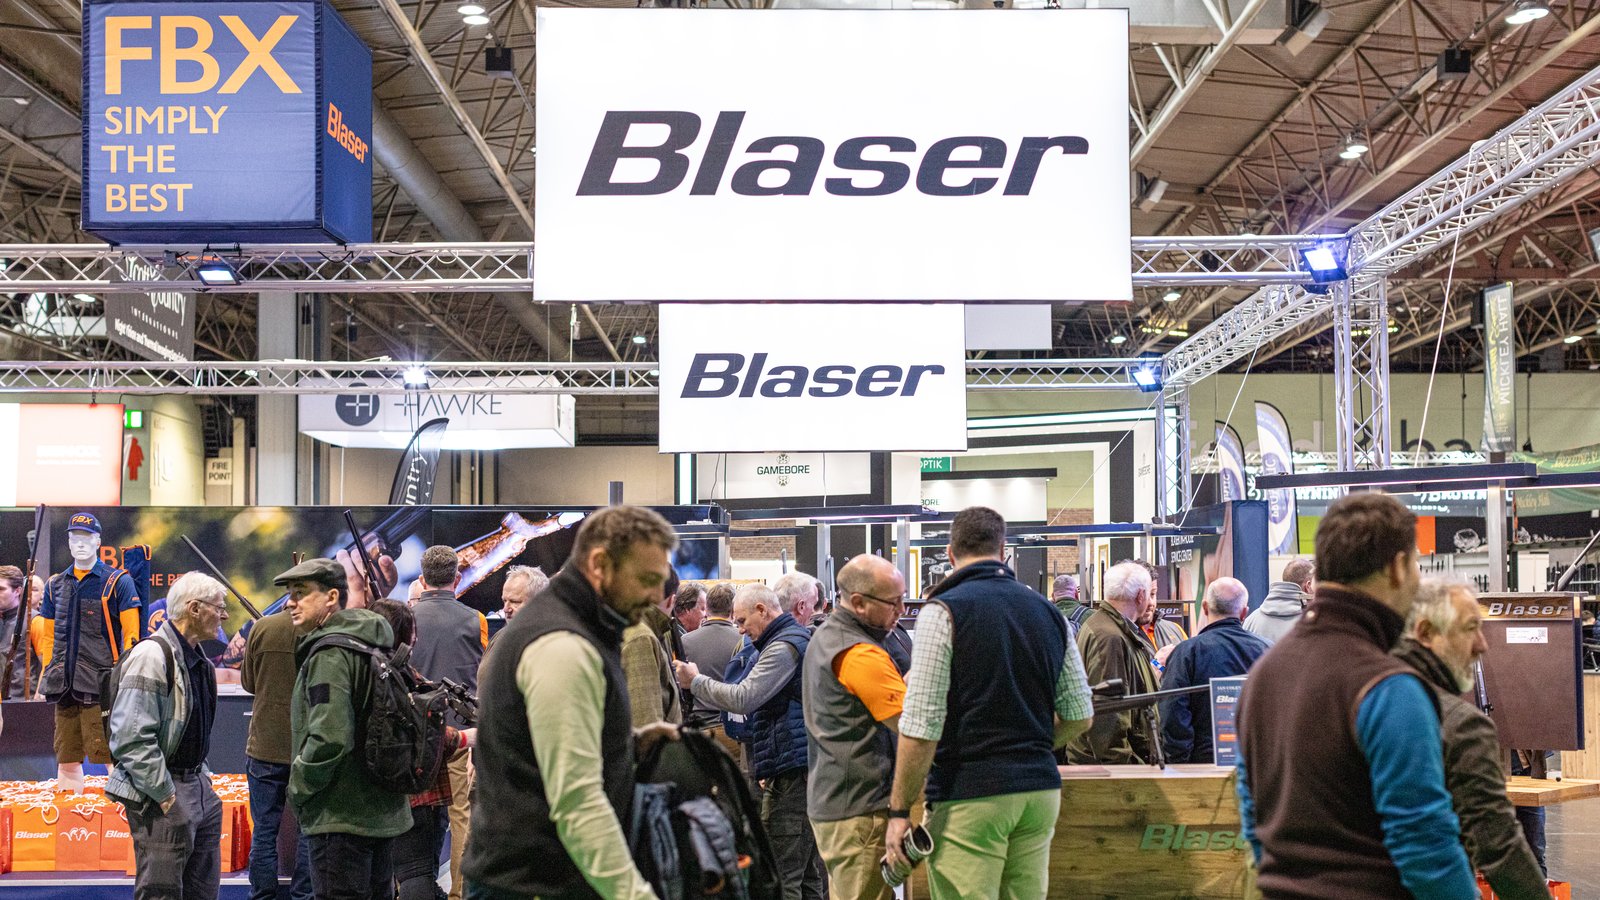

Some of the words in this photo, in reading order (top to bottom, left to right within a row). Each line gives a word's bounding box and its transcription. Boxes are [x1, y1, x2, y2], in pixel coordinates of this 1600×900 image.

[104, 15, 303, 95] FBX
[104, 105, 229, 135] SIMPLY
[327, 101, 369, 165] Blaser
[101, 145, 176, 174] THE
[576, 111, 1089, 197] Blaser
[105, 184, 194, 213] BEST
[680, 353, 945, 399] Blaser
[394, 393, 503, 417] HAWKE
[211, 461, 229, 471] FIRE
[756, 464, 811, 476] GAMEBORE
[208, 471, 231, 481] POINT
[71, 515, 94, 526] FBX
[149, 574, 164, 587] HE
[1487, 602, 1568, 617] Blaser
[1215, 694, 1238, 704] Bla
[14, 830, 53, 839] Blaser
[104, 829, 130, 838] Blas
[1140, 824, 1247, 850] Blas
